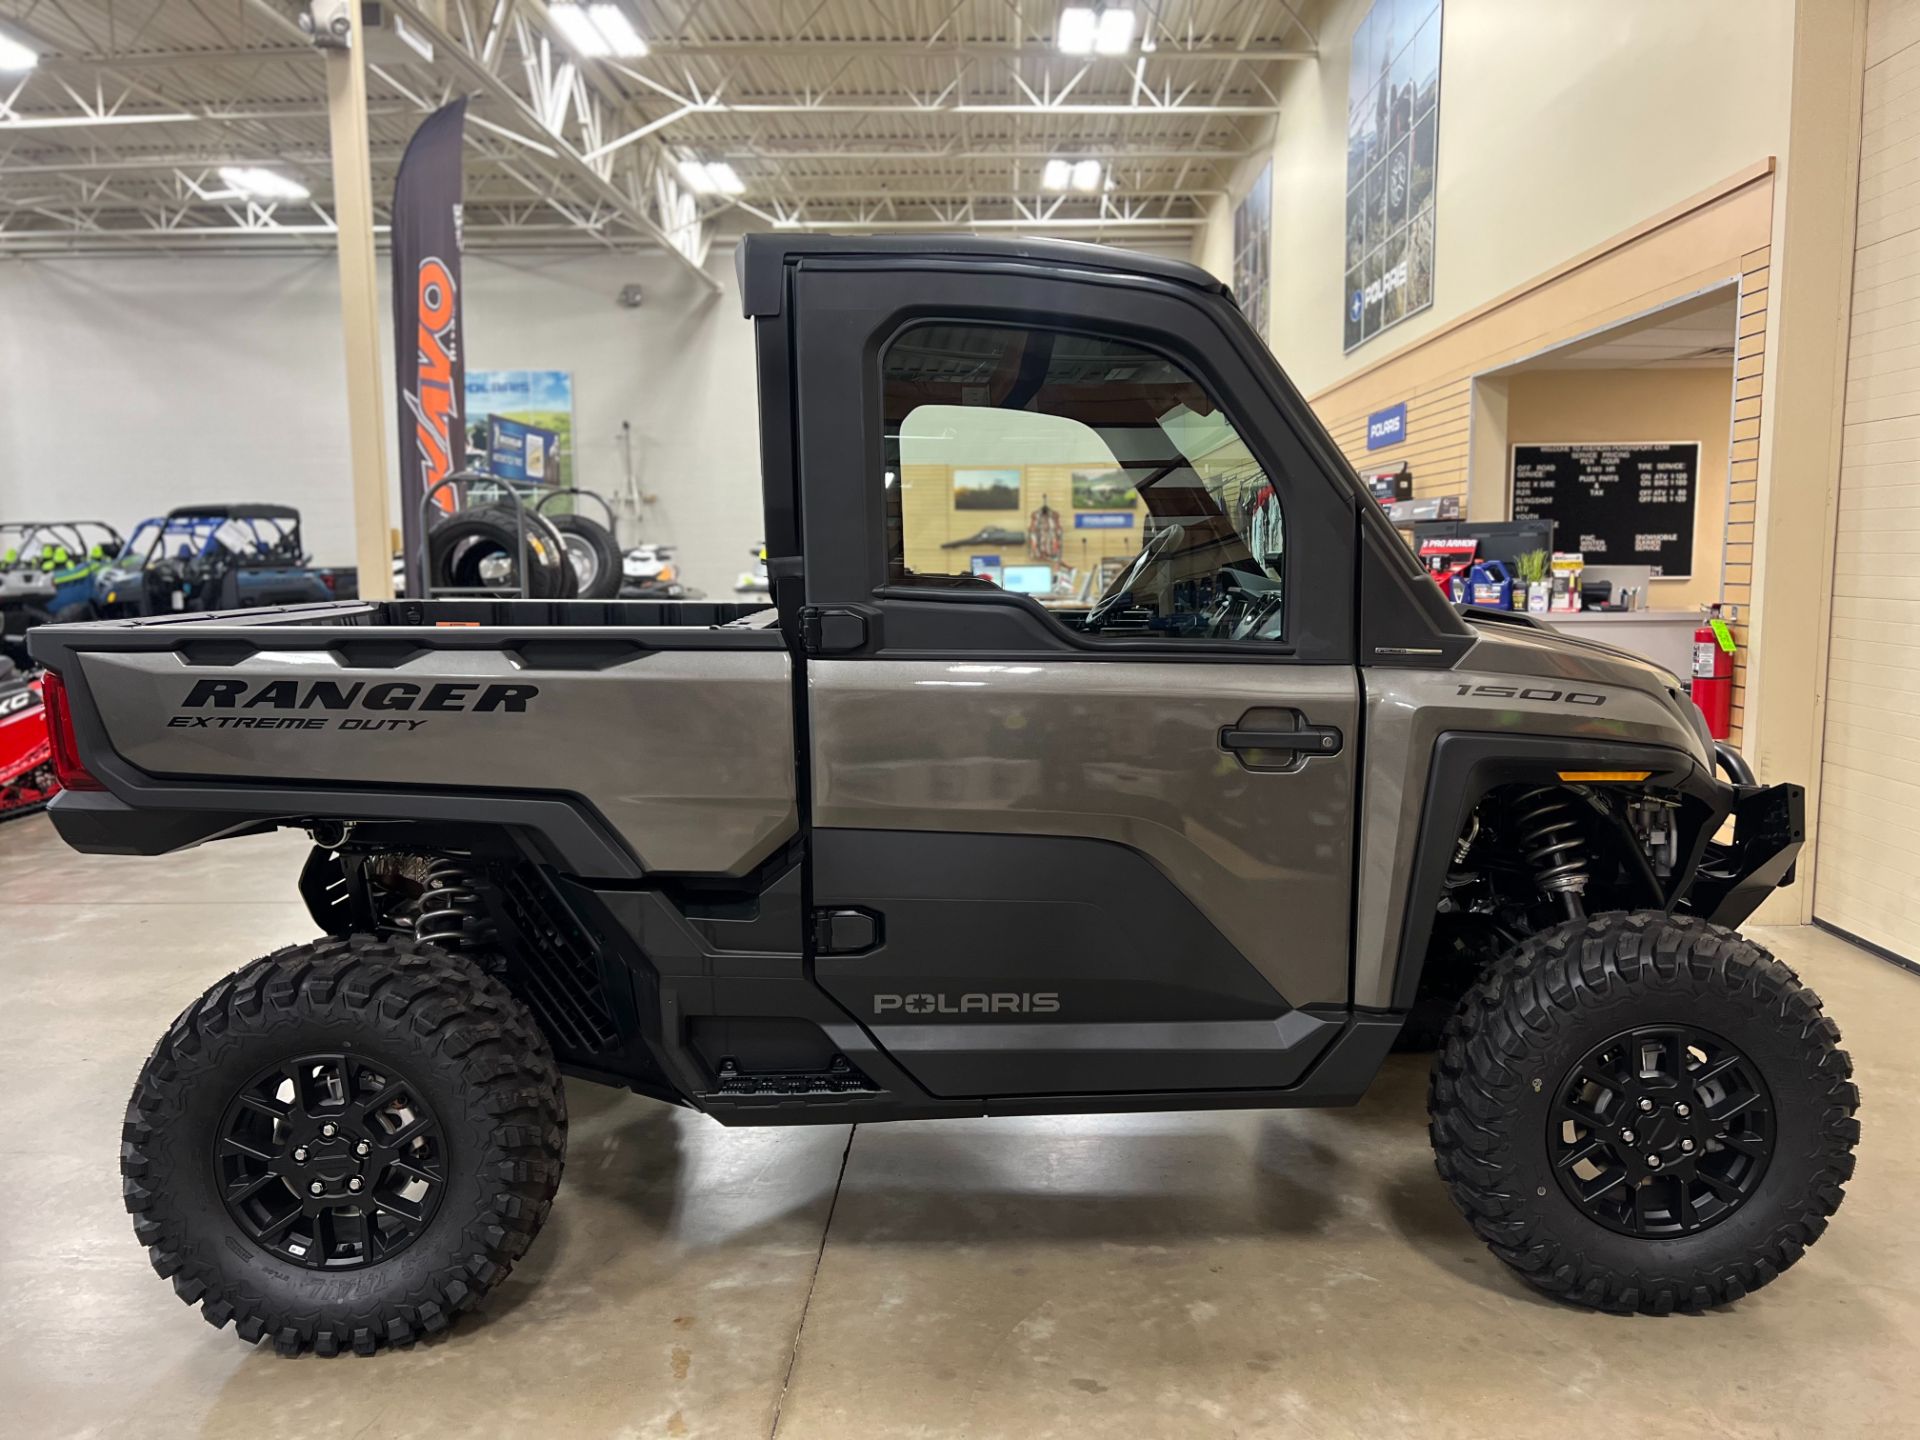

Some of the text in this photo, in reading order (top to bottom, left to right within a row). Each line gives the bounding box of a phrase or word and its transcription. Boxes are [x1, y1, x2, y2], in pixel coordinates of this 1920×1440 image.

[1365, 261, 1407, 309] POLARIS
[1370, 416, 1400, 438] POLARIS
[1446, 539, 1477, 547] ARMOR
[181, 680, 539, 712] RANGER
[1457, 684, 1607, 705] 1500
[166, 716, 429, 731] EXTREME DUTY
[873, 992, 1061, 1014] POLARIS
